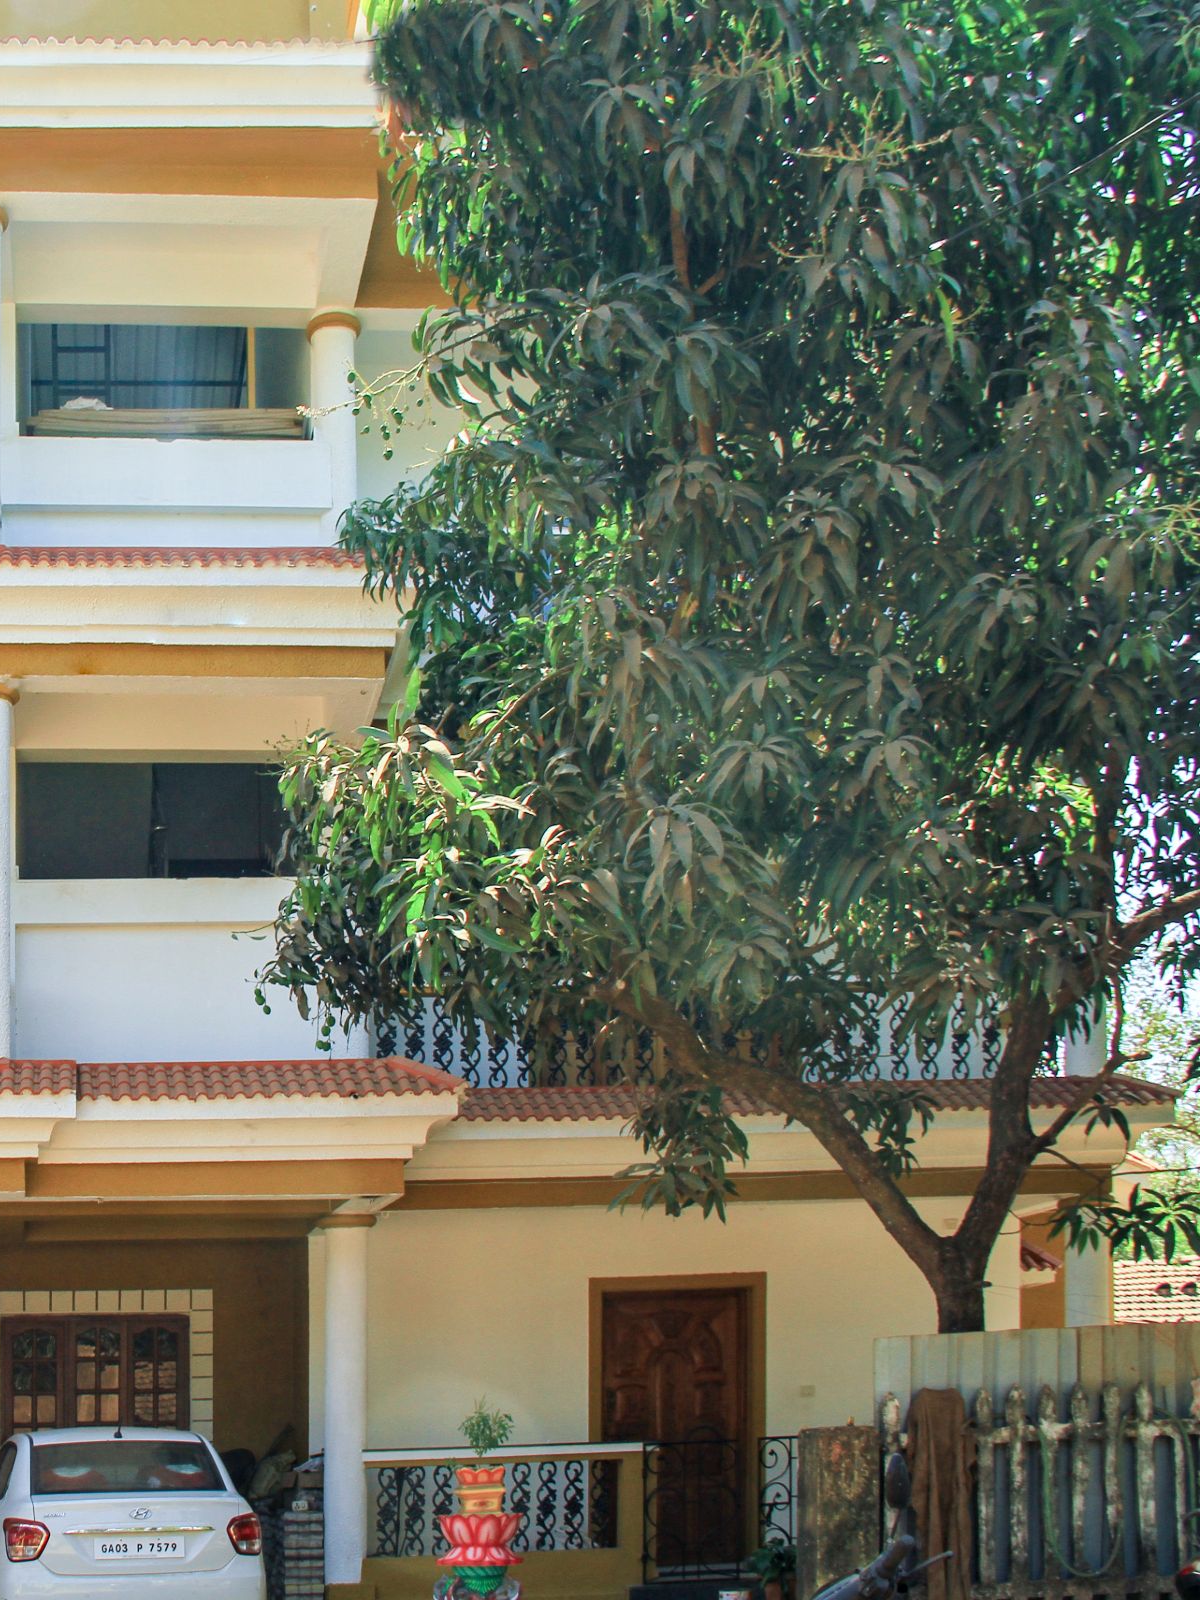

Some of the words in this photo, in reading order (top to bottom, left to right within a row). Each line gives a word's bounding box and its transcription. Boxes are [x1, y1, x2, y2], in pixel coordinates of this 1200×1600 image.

[101, 1543, 128, 1553] GA03
[136, 1543, 143, 1552] P
[149, 1542, 177, 1552] 7579
